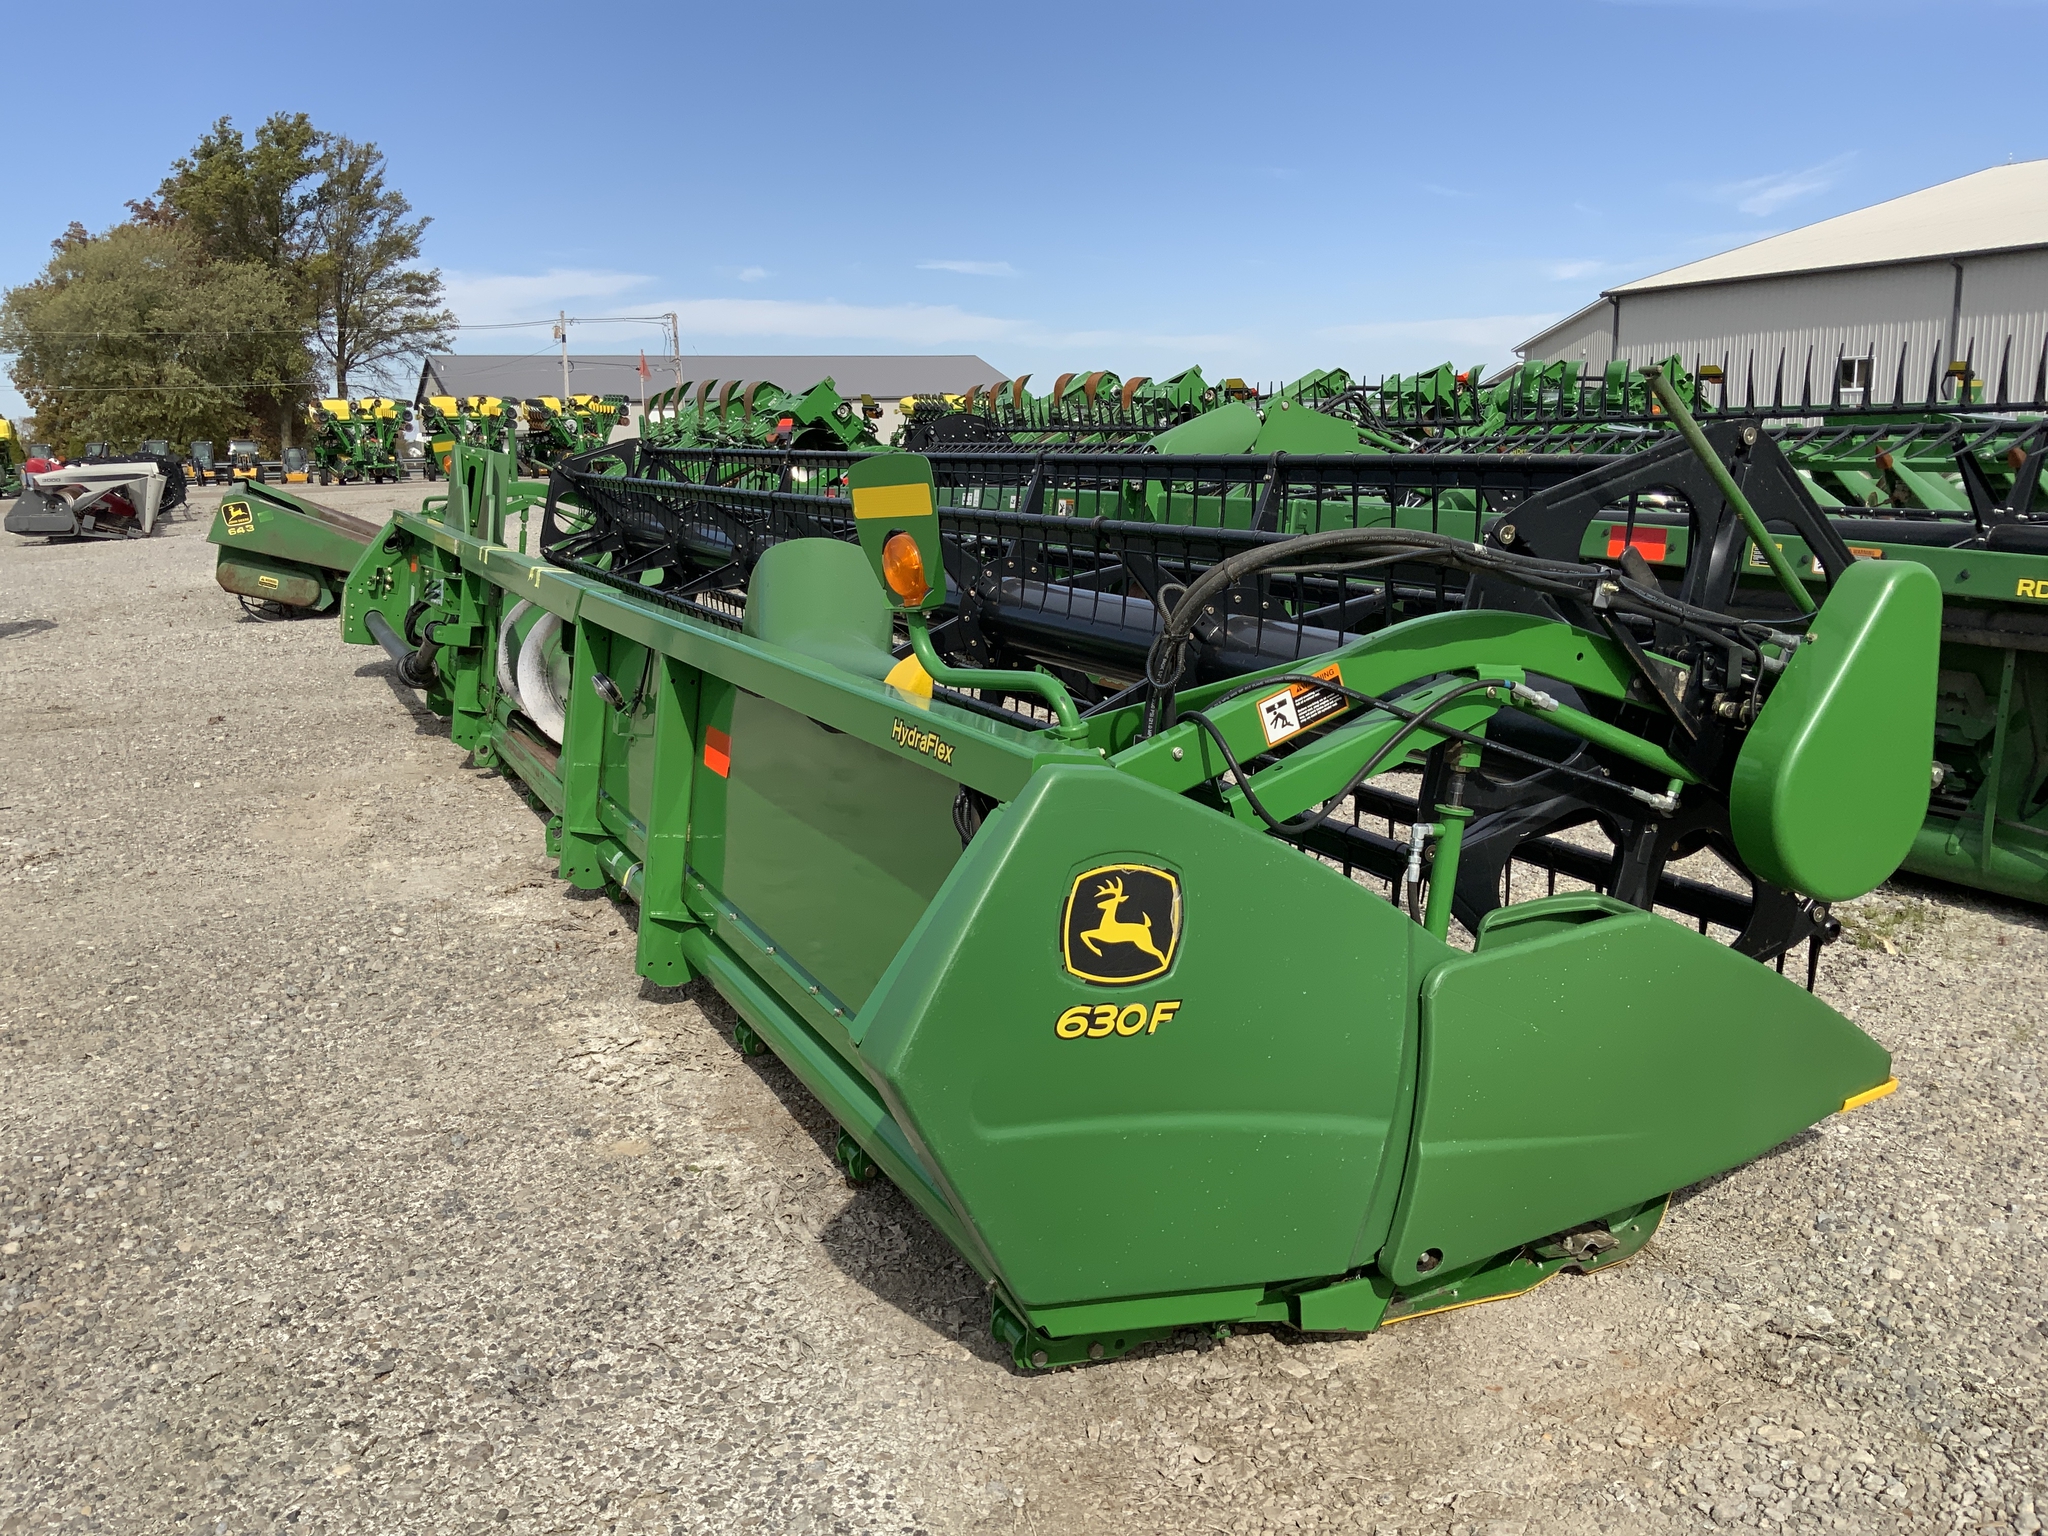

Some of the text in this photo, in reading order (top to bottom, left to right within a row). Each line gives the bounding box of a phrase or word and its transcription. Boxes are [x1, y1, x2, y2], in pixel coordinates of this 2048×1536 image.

[228, 525, 255, 535] 643
[891, 717, 955, 765] HydraFlex
[1054, 999, 1182, 1039] 630F
